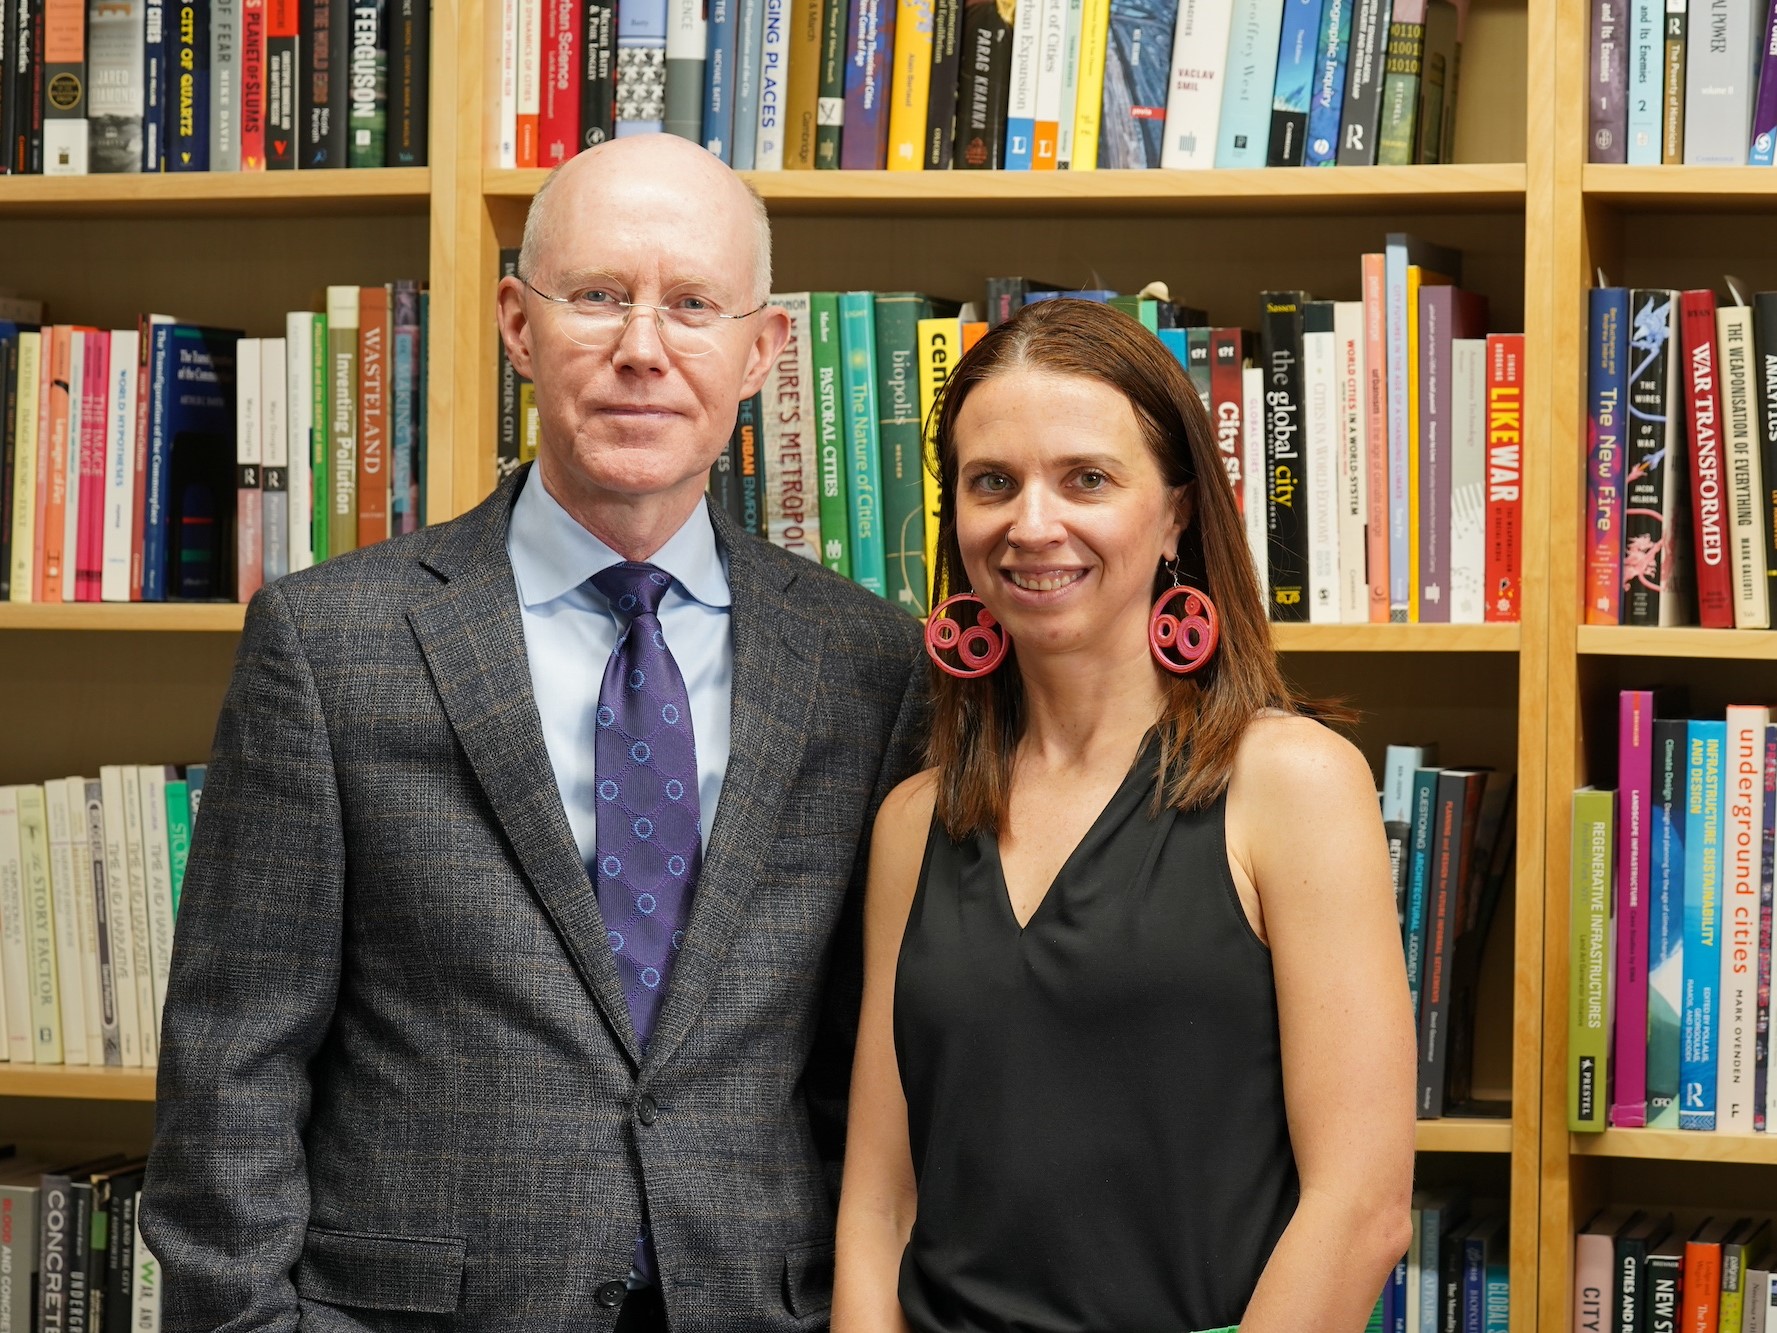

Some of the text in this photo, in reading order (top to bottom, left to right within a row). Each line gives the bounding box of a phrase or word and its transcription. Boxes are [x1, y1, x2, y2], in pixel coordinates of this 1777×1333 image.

[217, 23, 231, 64] FEAR
[313, 6, 328, 28] THE
[598, 7, 612, 79] MICHAEL BATTY
[1049, 14, 1064, 29] of
[1599, 3, 1616, 83] and Its Enemies
[1709, 13, 1727, 53] POWER
[180, 6, 194, 137] CITY OF QUARTZ
[313, 31, 328, 69] WORLD
[352, 7, 377, 117] FERGUSON
[557, 32, 574, 89] Science
[1045, 33, 1062, 74] Cities
[1639, 6, 1652, 84] and Its Enemies
[245, 12, 260, 133] PLANET OF SLUMS
[711, 48, 723, 113] MICHAEL BATTY
[762, 52, 779, 128] PLACES
[971, 28, 993, 129] PARAG KHANNA
[1016, 35, 1037, 111] Expansion
[1177, 68, 1215, 79] VACLAV
[1240, 64, 1256, 101] West
[1319, 60, 1338, 108] Inquiry
[219, 69, 230, 152] MIKE DAVIS
[311, 108, 321, 143] Perlroth
[320, 108, 330, 136] Nicole
[1639, 100, 1647, 112] 2
[1667, 45, 1681, 156] The Poverty of Historicism
[799, 111, 812, 164] Cambridge
[1267, 302, 1297, 314] Sassen
[1727, 322, 1743, 343] THE
[117, 369, 128, 411] WORLD
[362, 327, 382, 475] WASTELAND
[503, 362, 517, 444] MODERN CITY
[888, 350, 912, 425] biopolis
[1313, 383, 1329, 422] CITIES
[1599, 387, 1618, 427] The
[1635, 394, 1661, 404] WIRES
[1640, 381, 1656, 390] THE
[1729, 347, 1748, 438] WEAPONISATION
[333, 353, 355, 515] Inventing Pollution
[741, 425, 755, 475] URBAN
[819, 367, 838, 497] PASTORAL CITIES
[1249, 398, 1259, 475] GLOBAL CITIES
[1265, 350, 1299, 508] the global city
[1346, 339, 1360, 516] WORLD CITIES IN A WORLD-SYSTEM
[1490, 387, 1520, 502] LIKEWAR
[1637, 439, 1656, 448] WAR
[1641, 425, 1652, 434] OF
[1692, 342, 1722, 566] WAR TRANSFORMED
[1733, 442, 1748, 455] OF
[852, 383, 873, 538] The Nature of Cities
[1314, 445, 1330, 487] WORLD
[1598, 435, 1618, 478] New
[742, 477, 757, 533] ENVIRON
[780, 432, 805, 549] METROPOL
[1597, 486, 1617, 532] Fire
[1733, 458, 1752, 527] EVERYTHING
[1741, 537, 1751, 561] MARK
[1689, 737, 1704, 815] AND DESIGN
[149, 843, 164, 871] TIME
[170, 821, 188, 873] STORY
[1628, 789, 1640, 908] LANDSCAPE INFRASTRUCTURE
[1700, 738, 1720, 947] INFRASTRUCTURE SUSTAINABILITY
[1731, 729, 1759, 974] underground cities
[106, 843, 130, 979] TIME AND NARRATIVE
[127, 842, 150, 977] TIME AND NARRATIVE
[152, 875, 166, 906] AND
[1408, 786, 1431, 984] QUESTIONING ARCHITECTURAL JUDGMENT
[31, 875, 53, 1007] STORY FACTOR
[1587, 821, 1606, 1029] REGENERATIVE INFRASTRUCTURES
[1703, 986, 1711, 1014] EDITED
[1703, 1014, 1710, 1025] BY
[1733, 988, 1744, 1084] MARK OVENDEN
[1581, 1071, 1592, 1116] PRESTEL
[45, 1189, 66, 1333] CONCRETE
[1727, 1256, 1740, 1290] palgrave
[1445, 1282, 1459, 1333] The Morality
[1487, 1281, 1509, 1326] GLOBAL
[1582, 1287, 1601, 1333] CITY
[1622, 1256, 1636, 1322] CITIES AND
[1655, 1279, 1675, 1318] NEW
[1696, 1304, 1708, 1321] The
[140, 1307, 154, 1330] AND
